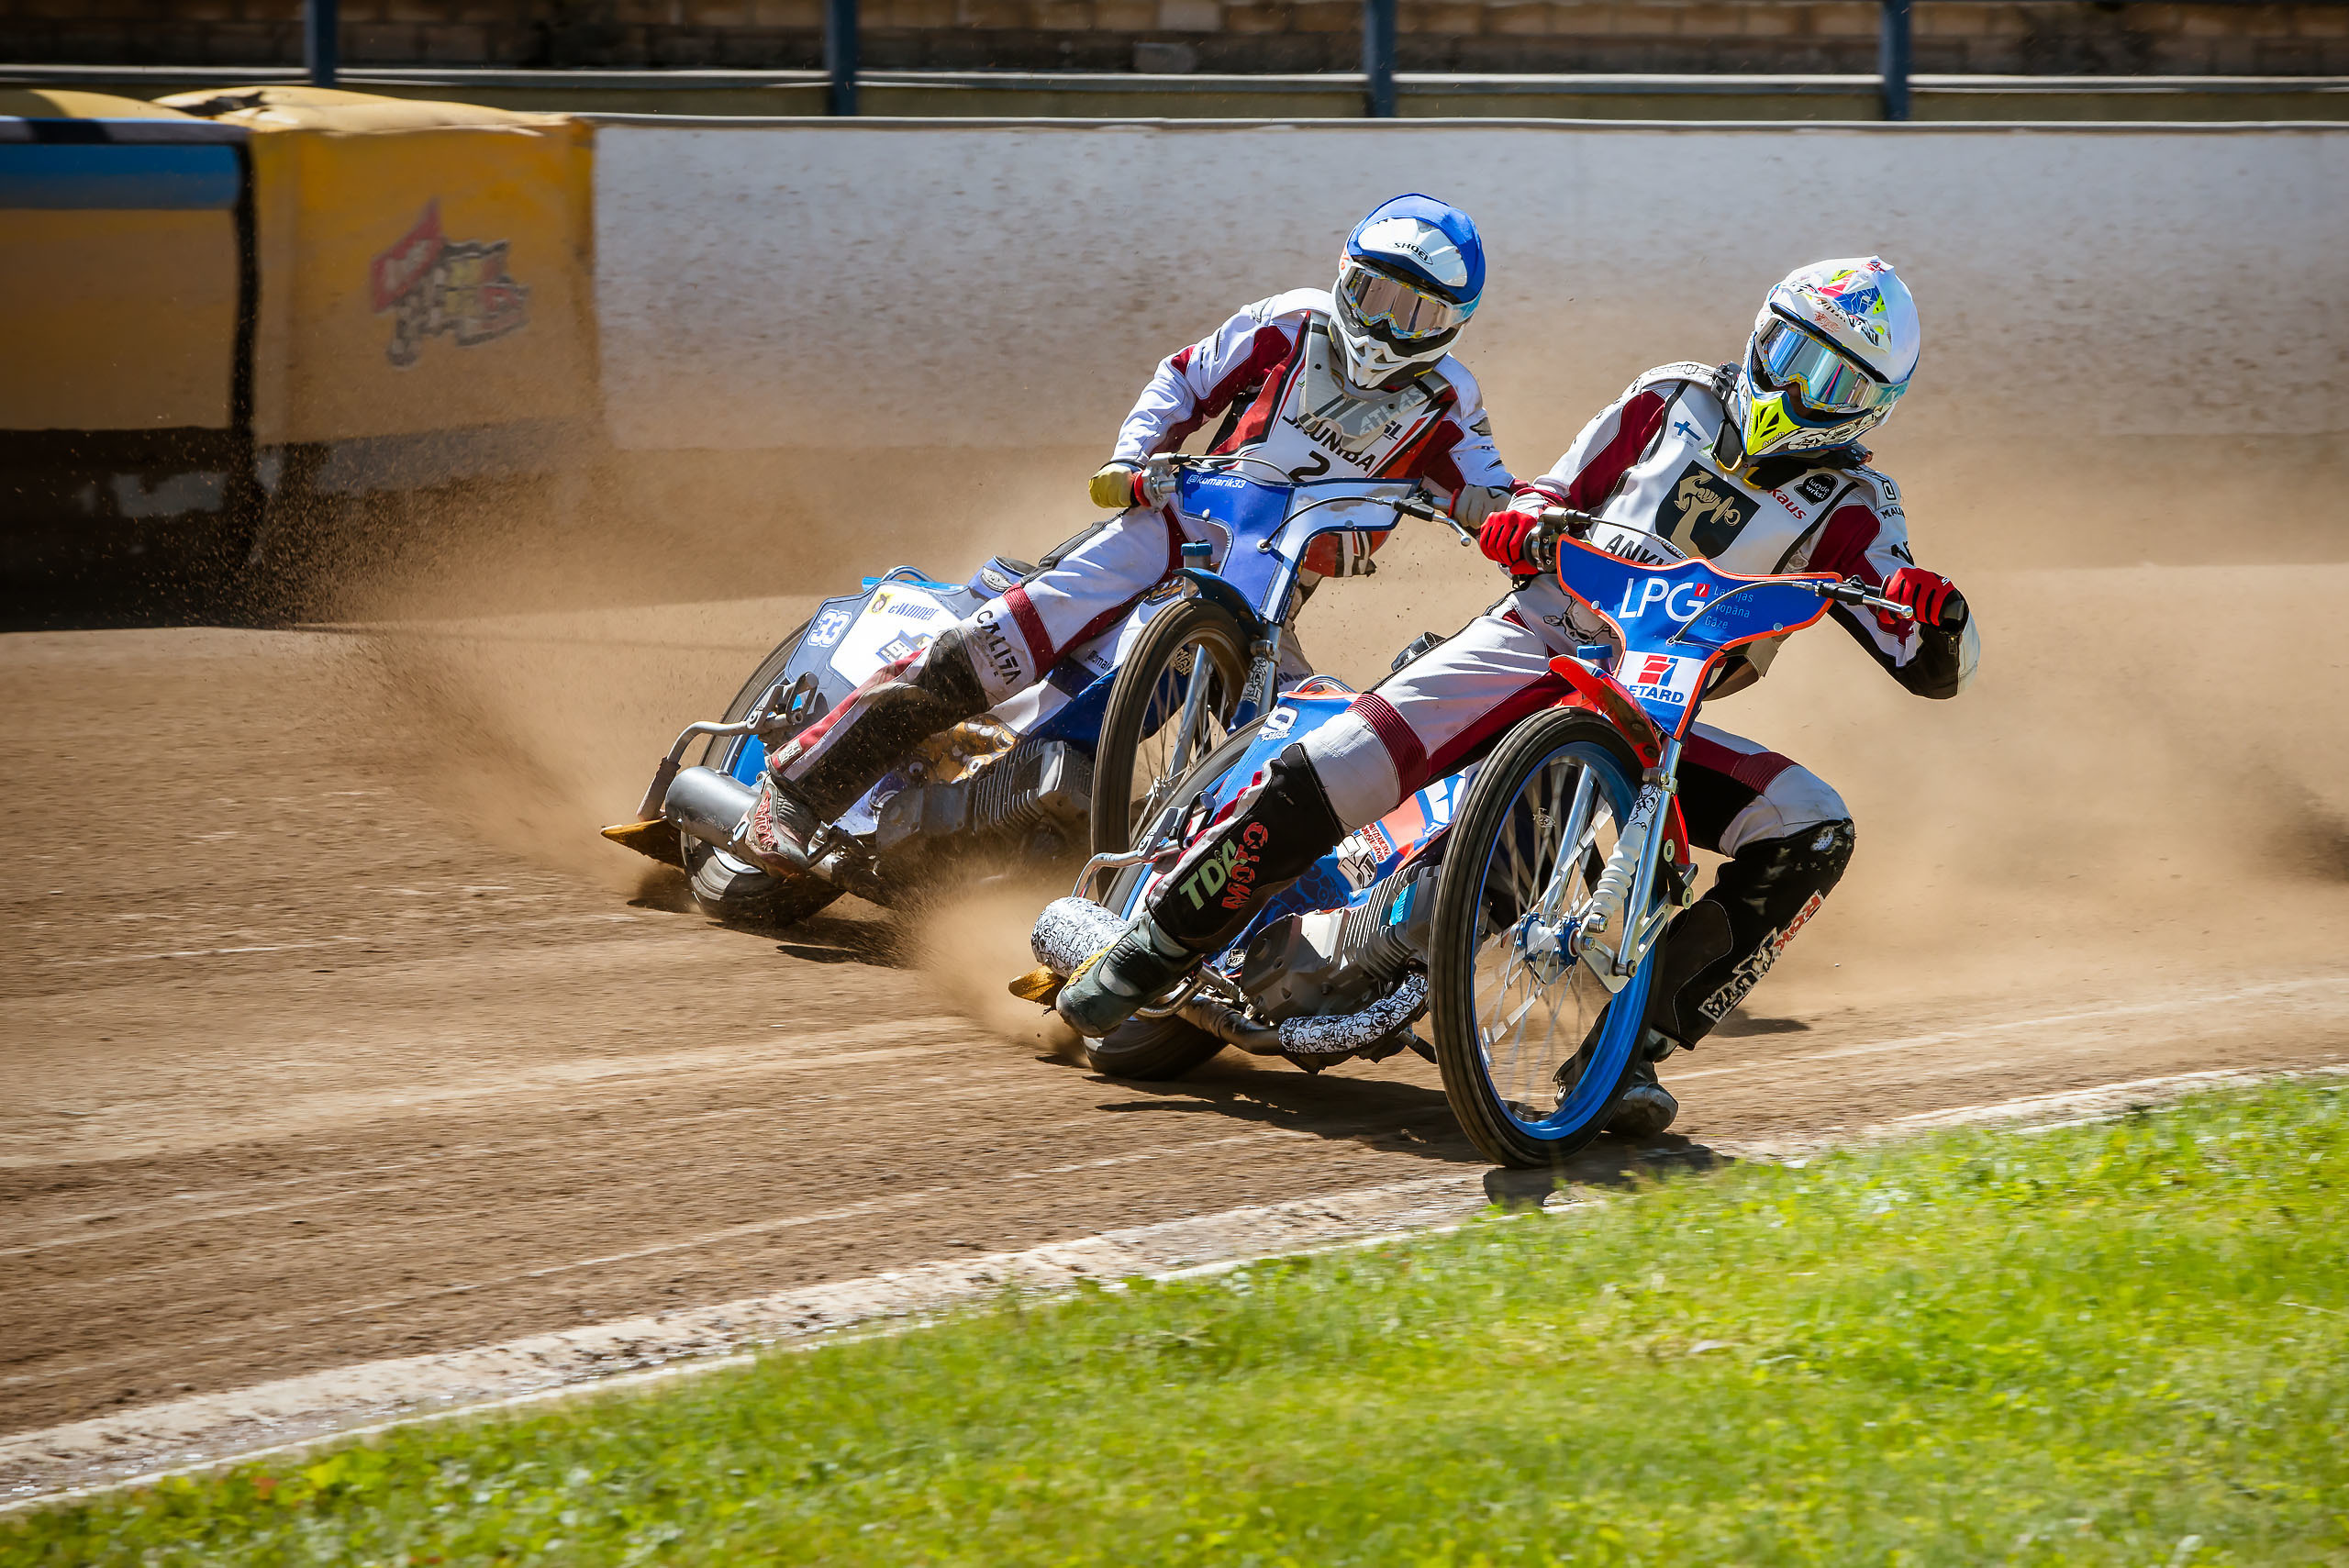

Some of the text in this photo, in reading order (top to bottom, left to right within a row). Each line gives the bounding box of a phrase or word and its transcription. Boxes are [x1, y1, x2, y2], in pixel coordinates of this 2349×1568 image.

[1394, 241, 1429, 262] SHOEI
[1359, 386, 1423, 436] ATLAS
[1287, 450, 1330, 483] 2
[887, 602, 940, 621] eWinner
[1618, 577, 1706, 622] LPG
[1715, 602, 1751, 618] ropāna
[807, 608, 852, 649] 33
[1623, 684, 1685, 704] ETARD
